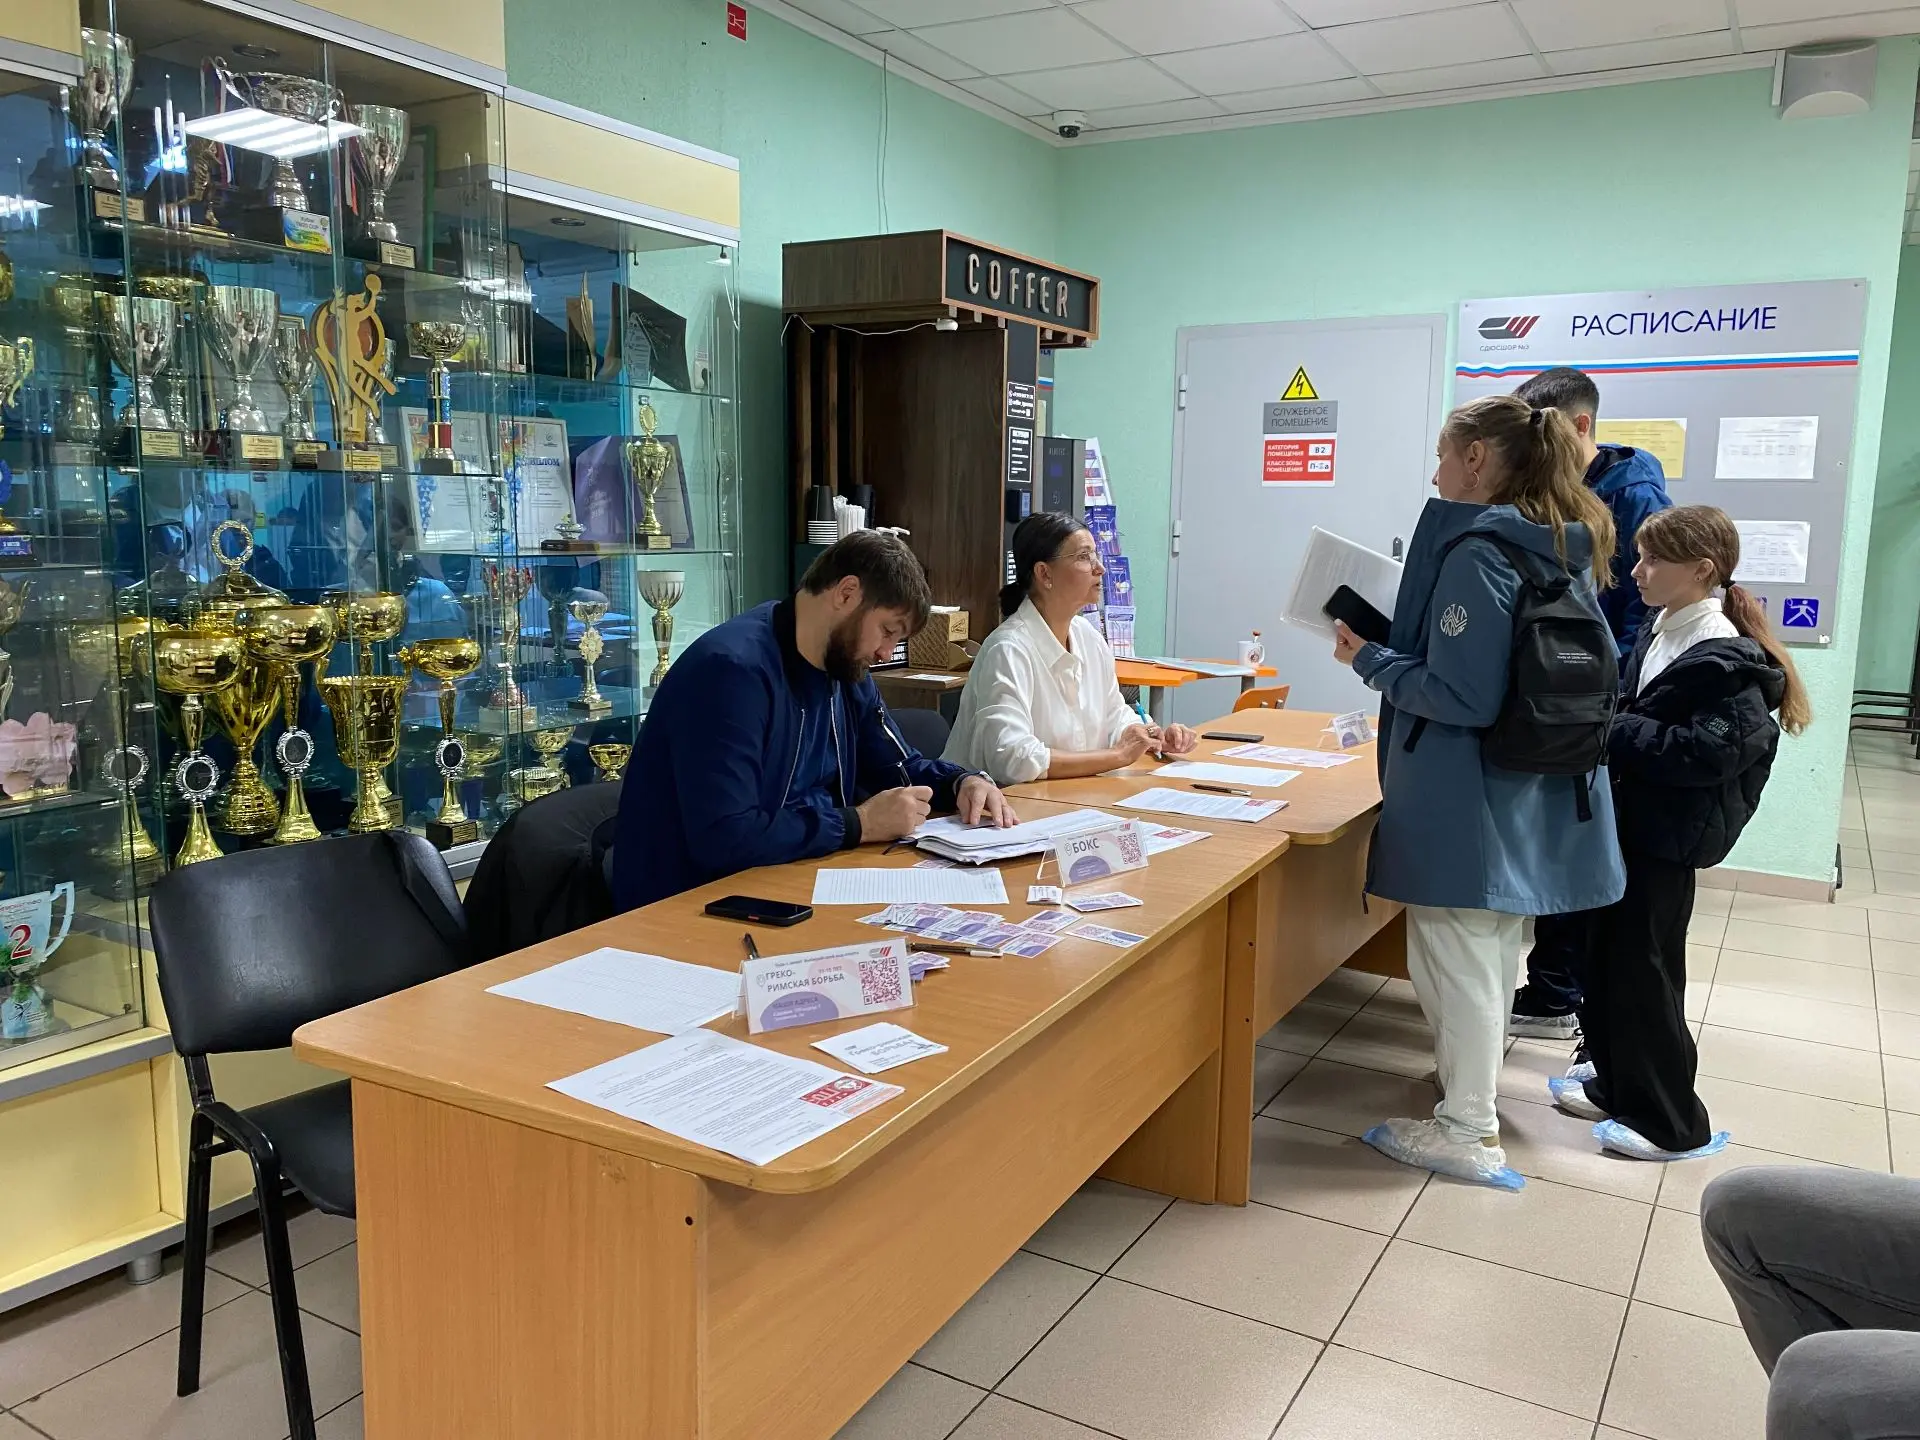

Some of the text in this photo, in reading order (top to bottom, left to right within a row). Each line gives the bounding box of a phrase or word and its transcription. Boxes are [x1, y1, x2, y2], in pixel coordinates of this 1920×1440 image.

[967, 252, 1069, 319] COFFER
[1571, 305, 1778, 337] РАСПИСАНИЕ
[1272, 407, 1328, 416] СЛУЖЕБНОЕ
[1072, 838, 1100, 853] БОКС
[9, 924, 33, 959] 2
[765, 969, 797, 982] ГРЕКО-
[767, 972, 845, 993] РИМСКАЯ БОРЬБА
